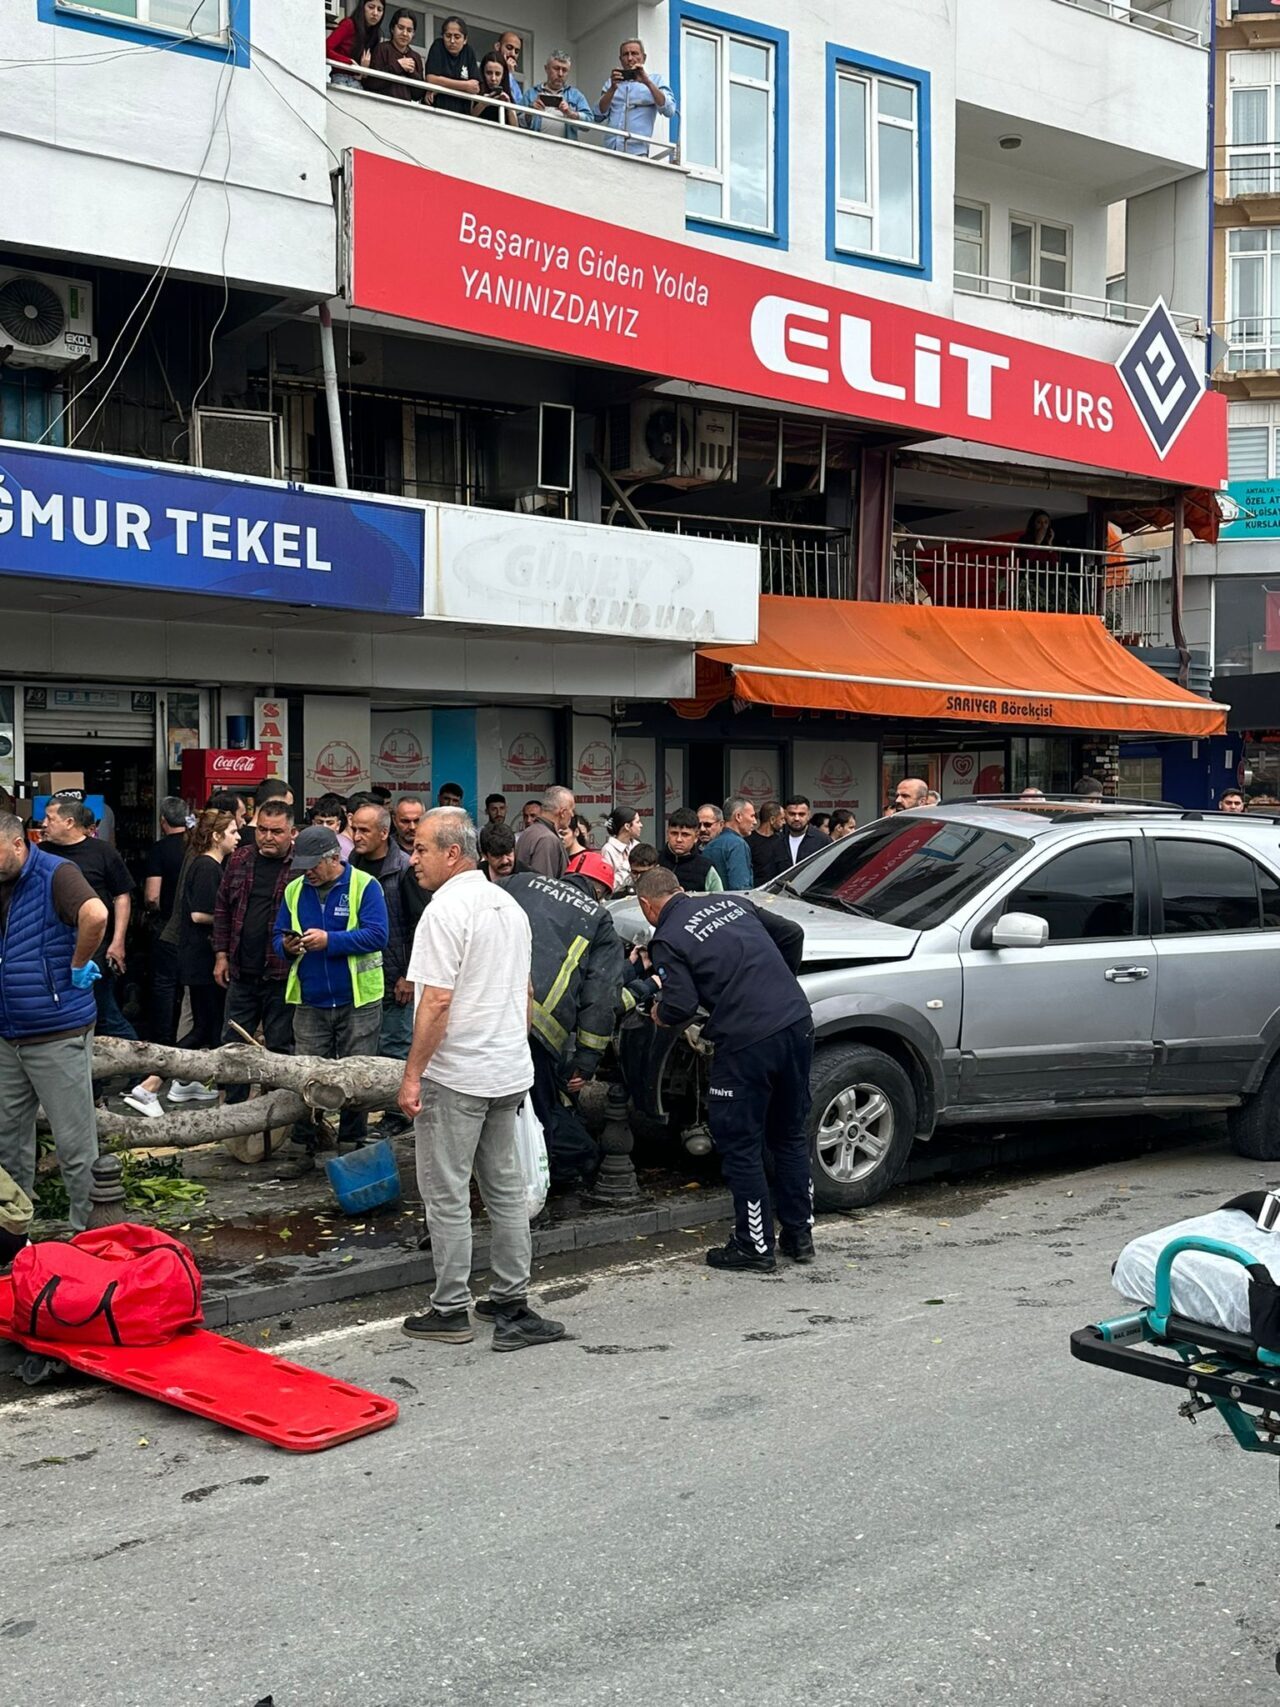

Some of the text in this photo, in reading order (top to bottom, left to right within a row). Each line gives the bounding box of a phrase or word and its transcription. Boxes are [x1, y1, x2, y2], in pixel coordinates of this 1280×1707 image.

[458, 211, 710, 307] Başarıya Giden Yolda
[460, 265, 640, 339] YANINIZDAYIZ
[1033, 379, 1114, 433] KURS
[1245, 495, 1266, 506] ÖZEL
[165, 508, 332, 572] TEKEL
[946, 696, 1053, 720] SARIYER Börekçisi
[684, 900, 738, 934] ANTALYA
